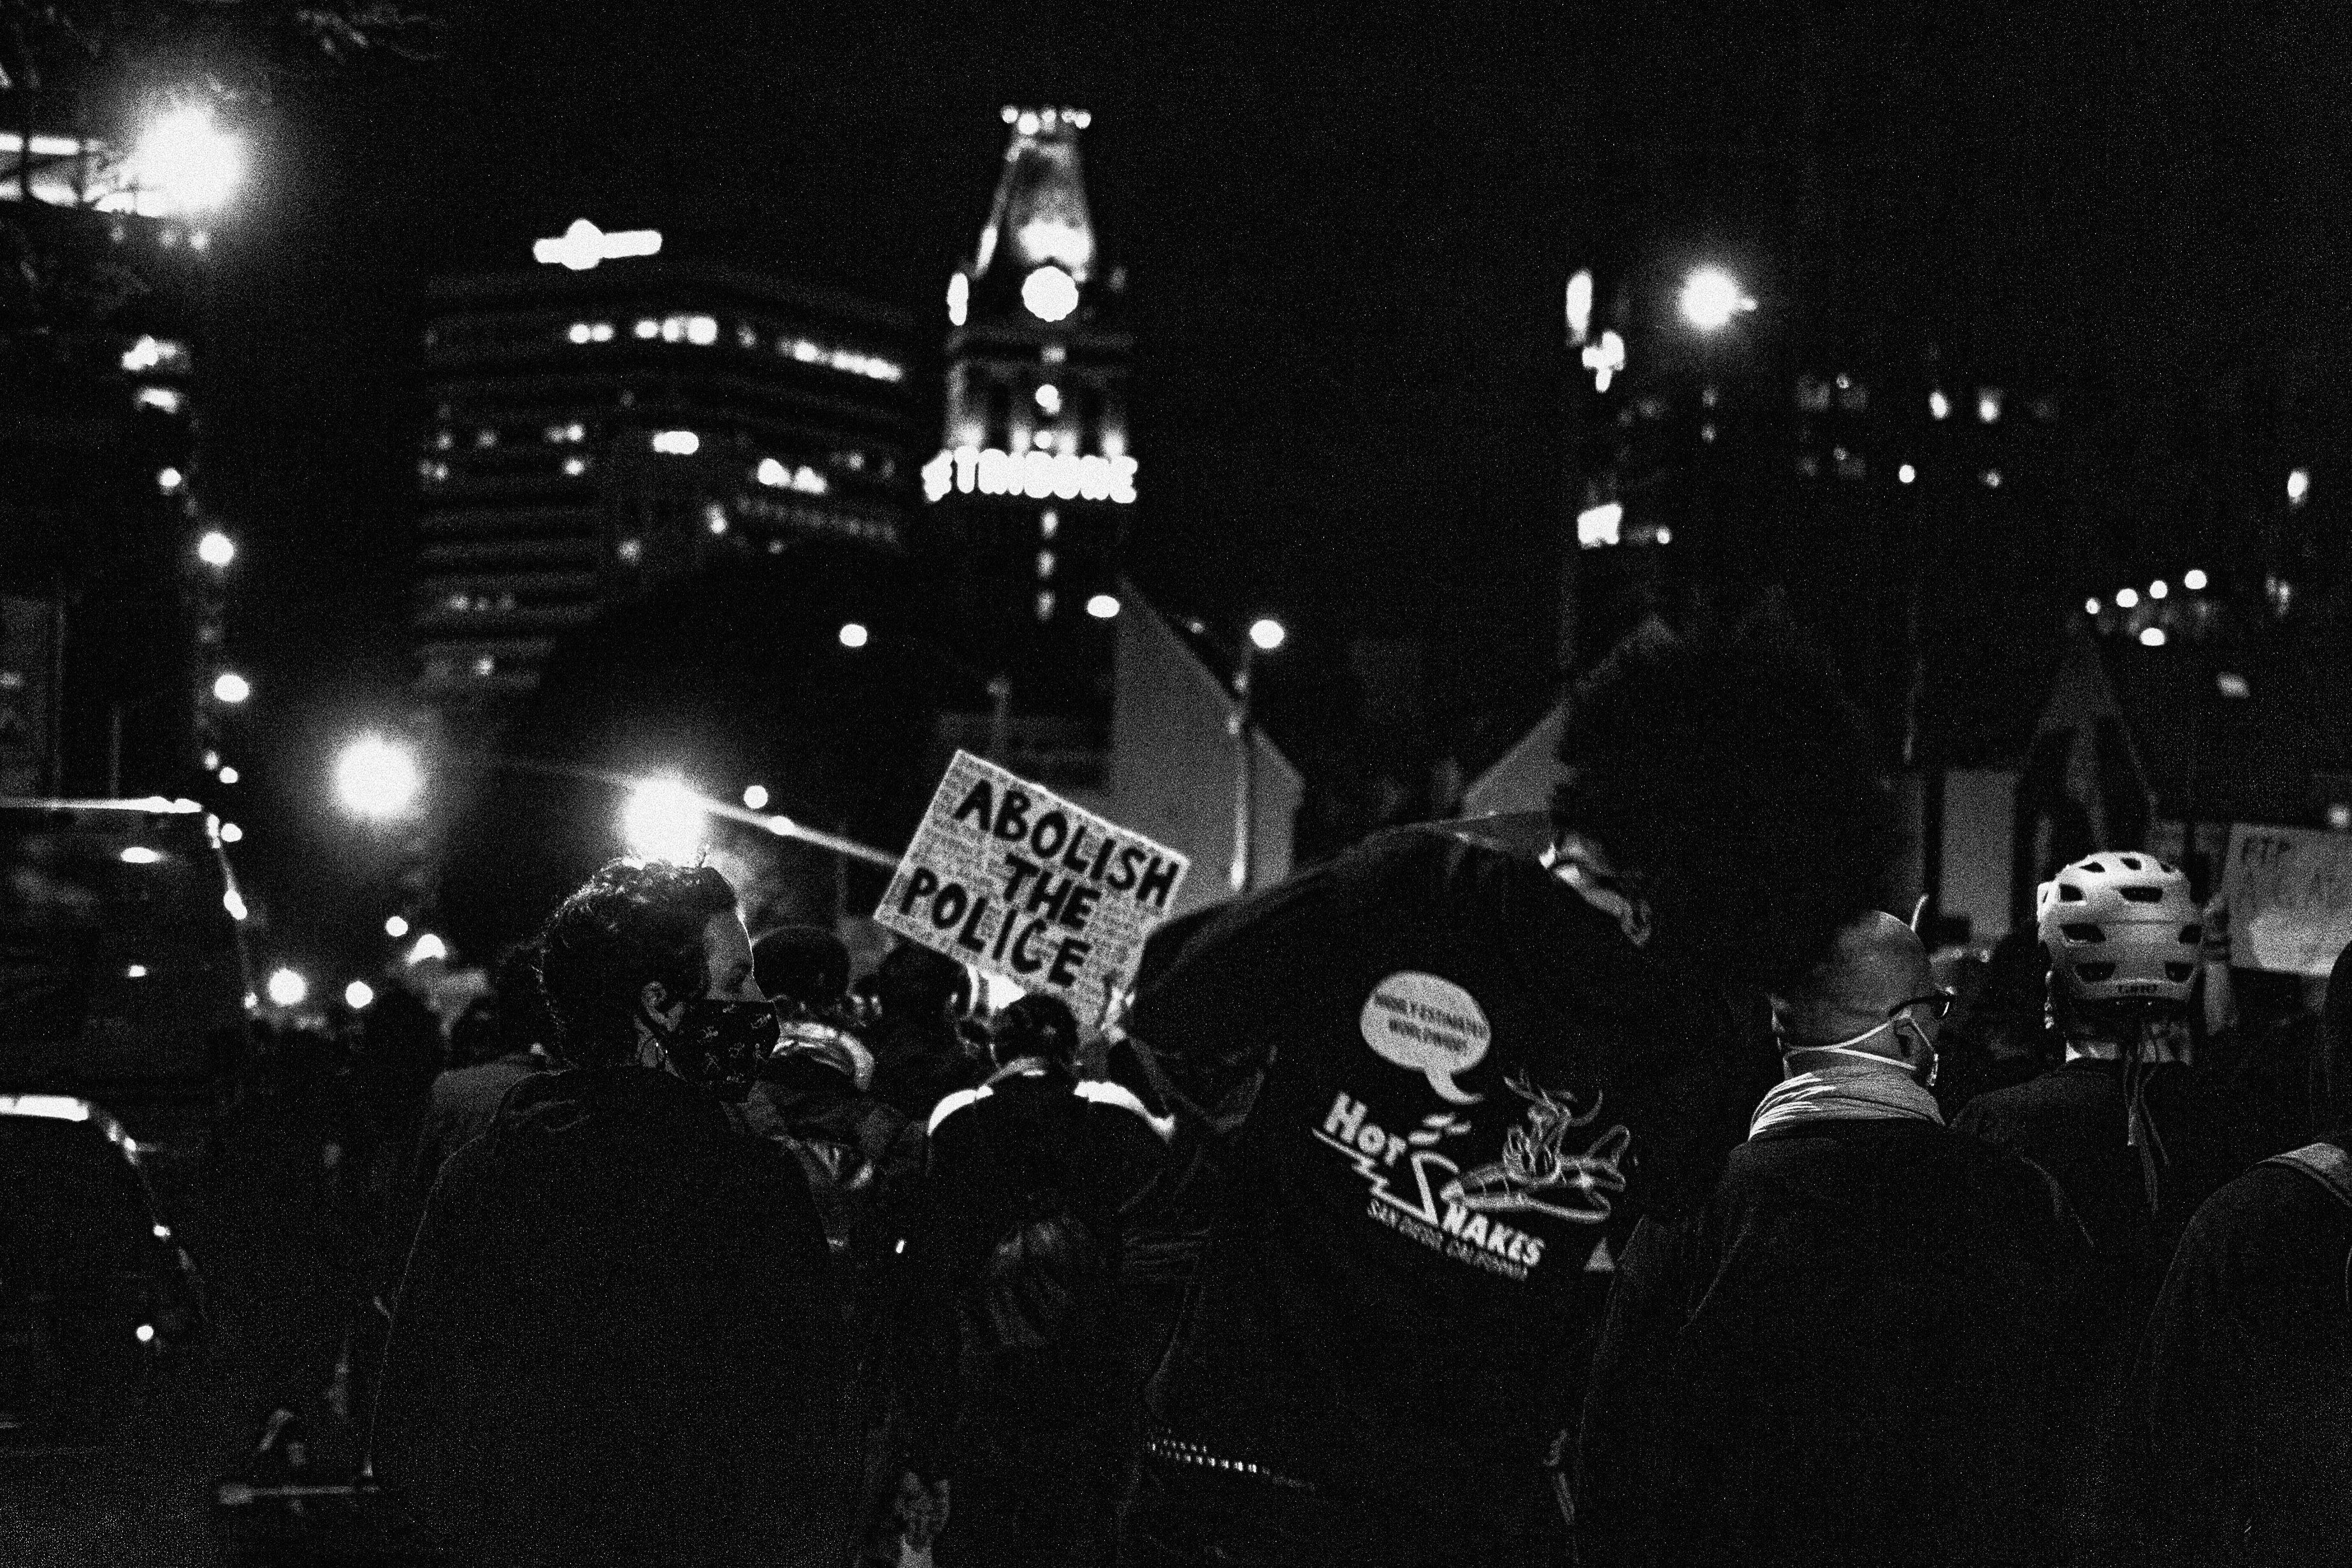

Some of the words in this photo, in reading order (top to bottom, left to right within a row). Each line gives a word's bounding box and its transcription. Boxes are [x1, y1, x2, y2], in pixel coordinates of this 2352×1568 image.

[955, 779, 1179, 907] ABOLISH
[1004, 851, 1100, 929] THE
[899, 867, 1091, 987] POLICE
